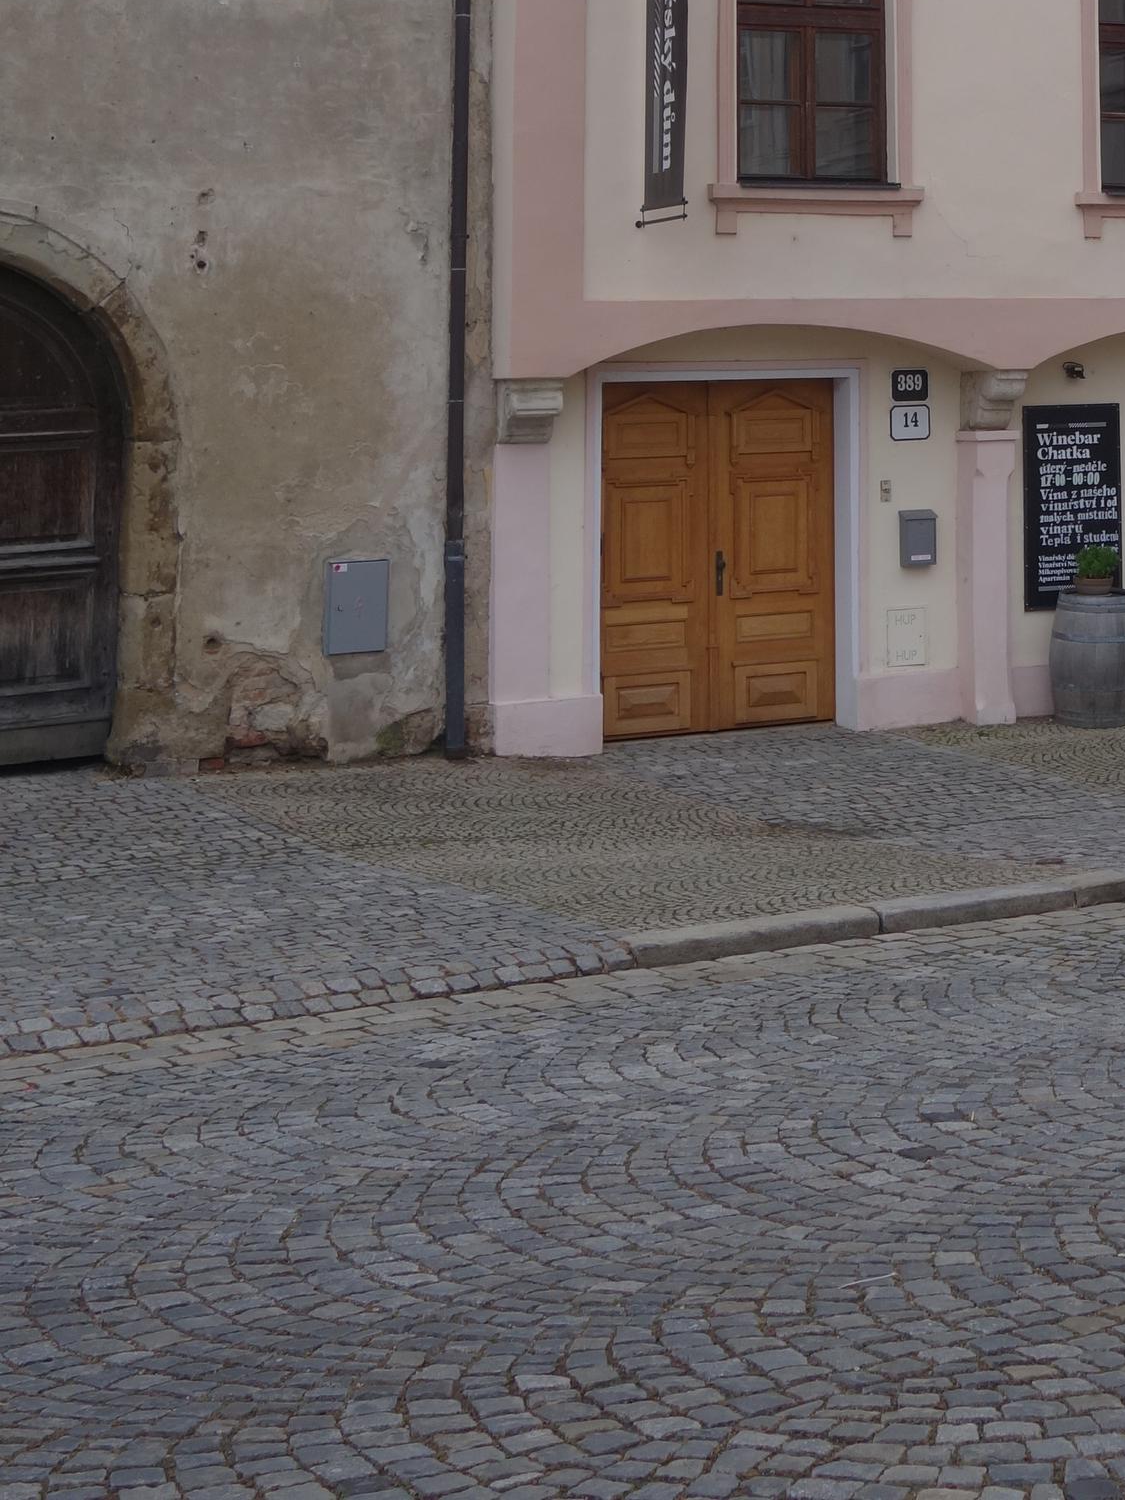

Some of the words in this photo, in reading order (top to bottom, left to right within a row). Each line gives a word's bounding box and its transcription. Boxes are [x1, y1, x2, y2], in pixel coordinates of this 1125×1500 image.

[661, 82, 676, 171] dům
[897, 374, 923, 391] 389
[903, 411, 919, 428] 14
[1036, 431, 1101, 446] Winebar
[1036, 445, 1090, 460] Chatka
[1071, 490, 1078, 499] z
[1080, 484, 1116, 497] našeho
[1106, 496, 1117, 507] od
[1076, 534, 1081, 543] i
